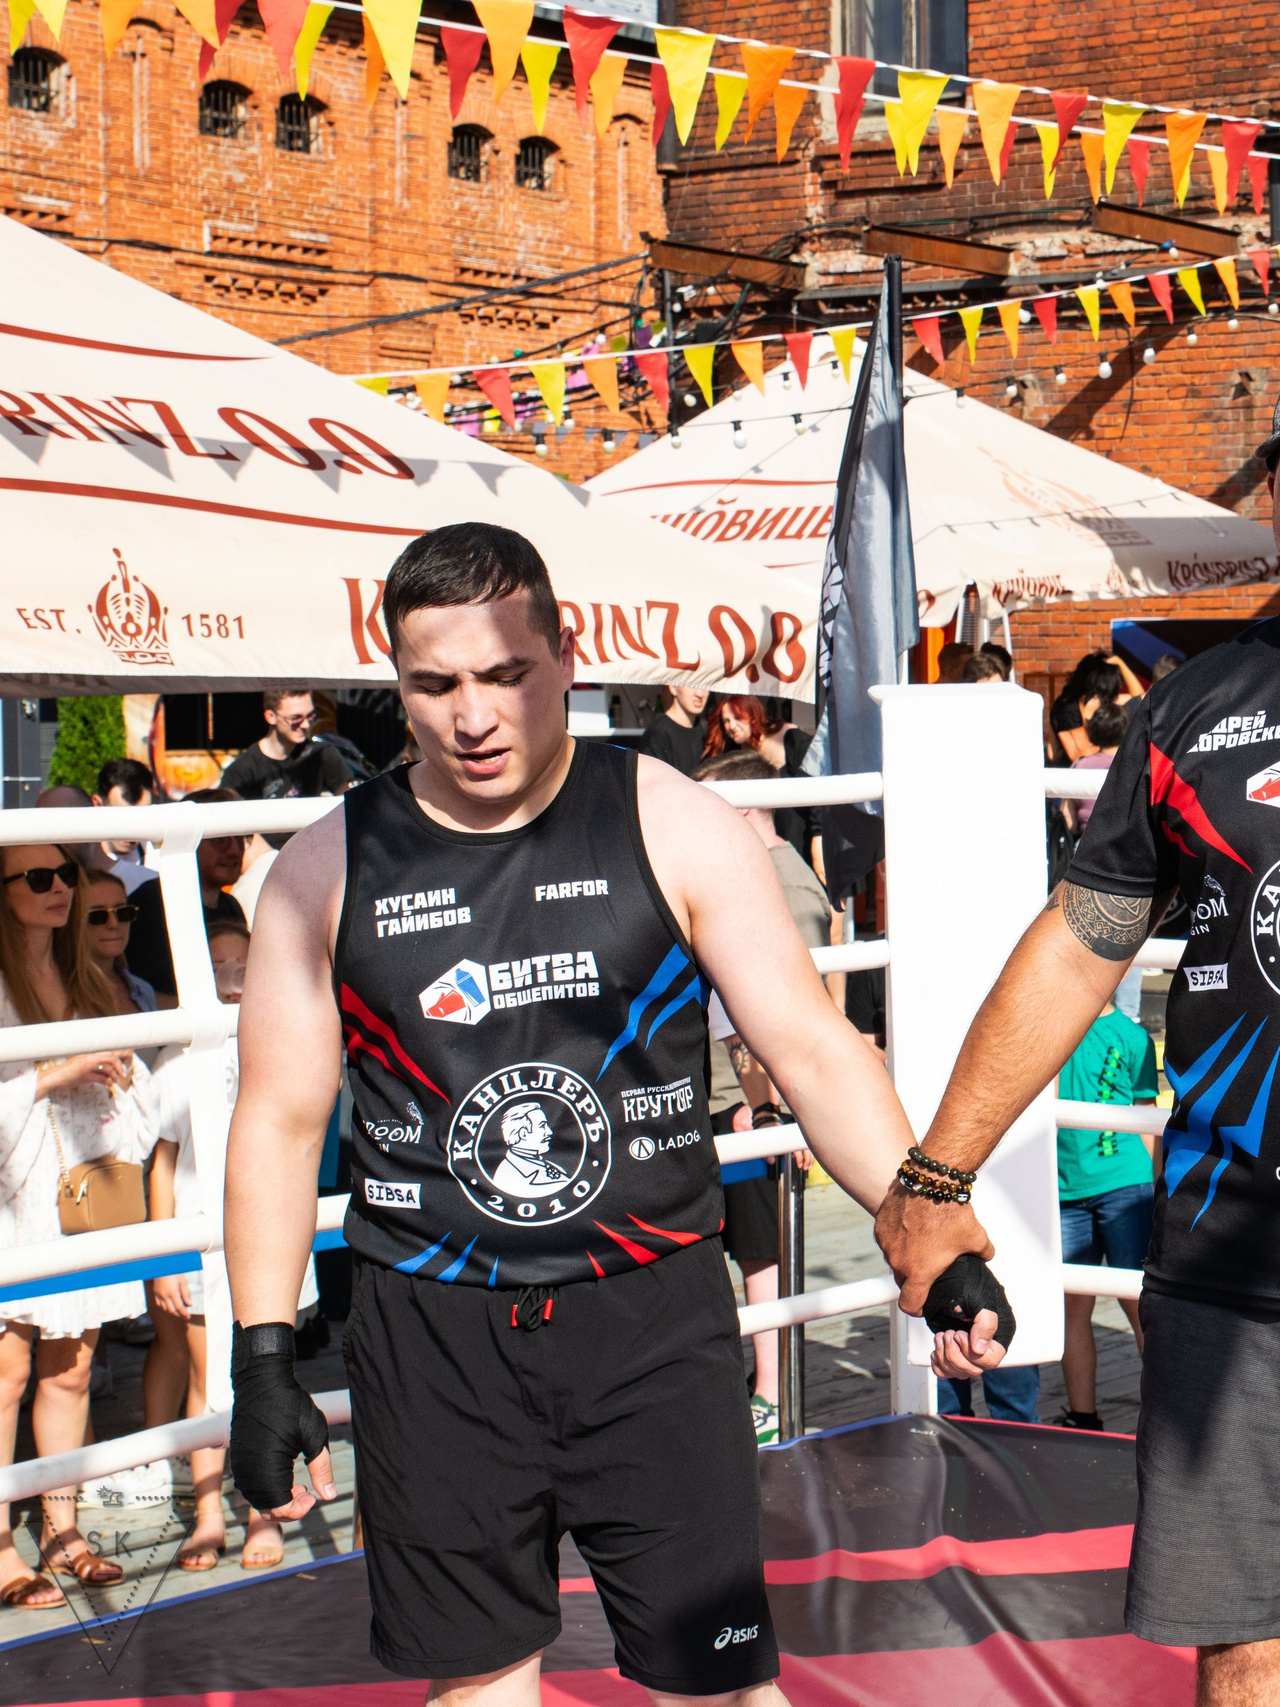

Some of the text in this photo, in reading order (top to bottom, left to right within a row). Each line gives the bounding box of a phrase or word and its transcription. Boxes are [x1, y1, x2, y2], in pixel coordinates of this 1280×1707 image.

[217, 407, 415, 479] 0.0
[16, 608, 245, 639] EST. 1581
[1211, 710, 1266, 733] ДРЕЙ
[375, 887, 456, 916] ХУСАИН
[535, 879, 609, 901] FARFOR
[376, 906, 471, 938] ГАЙИБОВ
[488, 951, 600, 992] БИТВА
[492, 981, 600, 1010] ОБЩЕПИТОВ
[453, 1069, 605, 1161] КАНЦЛЕРЪ
[658, 1129, 701, 1151] LADOG
[367, 1184, 416, 1204] SIBSA
[487, 1180, 591, 1218] 2010
[732, 1624, 759, 1644] asics
